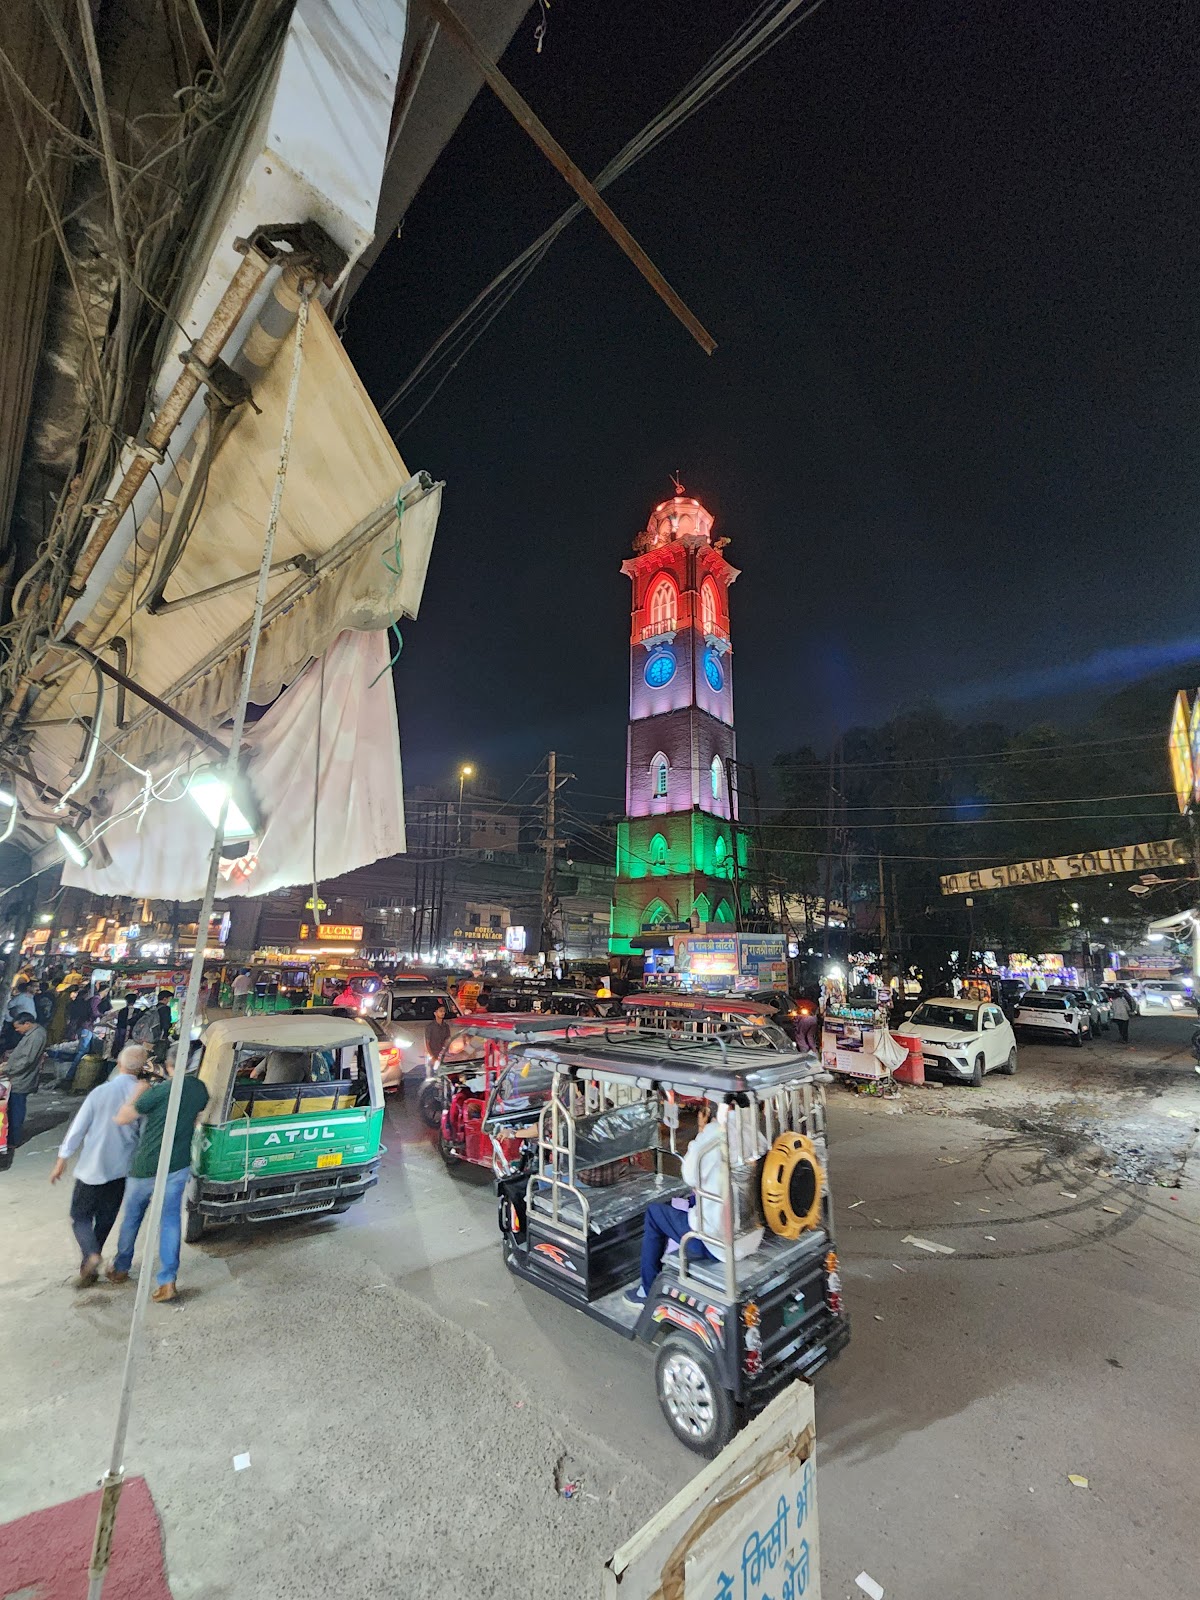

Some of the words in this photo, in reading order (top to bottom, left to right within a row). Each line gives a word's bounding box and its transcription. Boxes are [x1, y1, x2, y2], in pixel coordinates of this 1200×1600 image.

[320, 926, 353, 935] LUCKY
[715, 939, 735, 950] लॉटरी
[264, 1127, 336, 1146] ATUL
